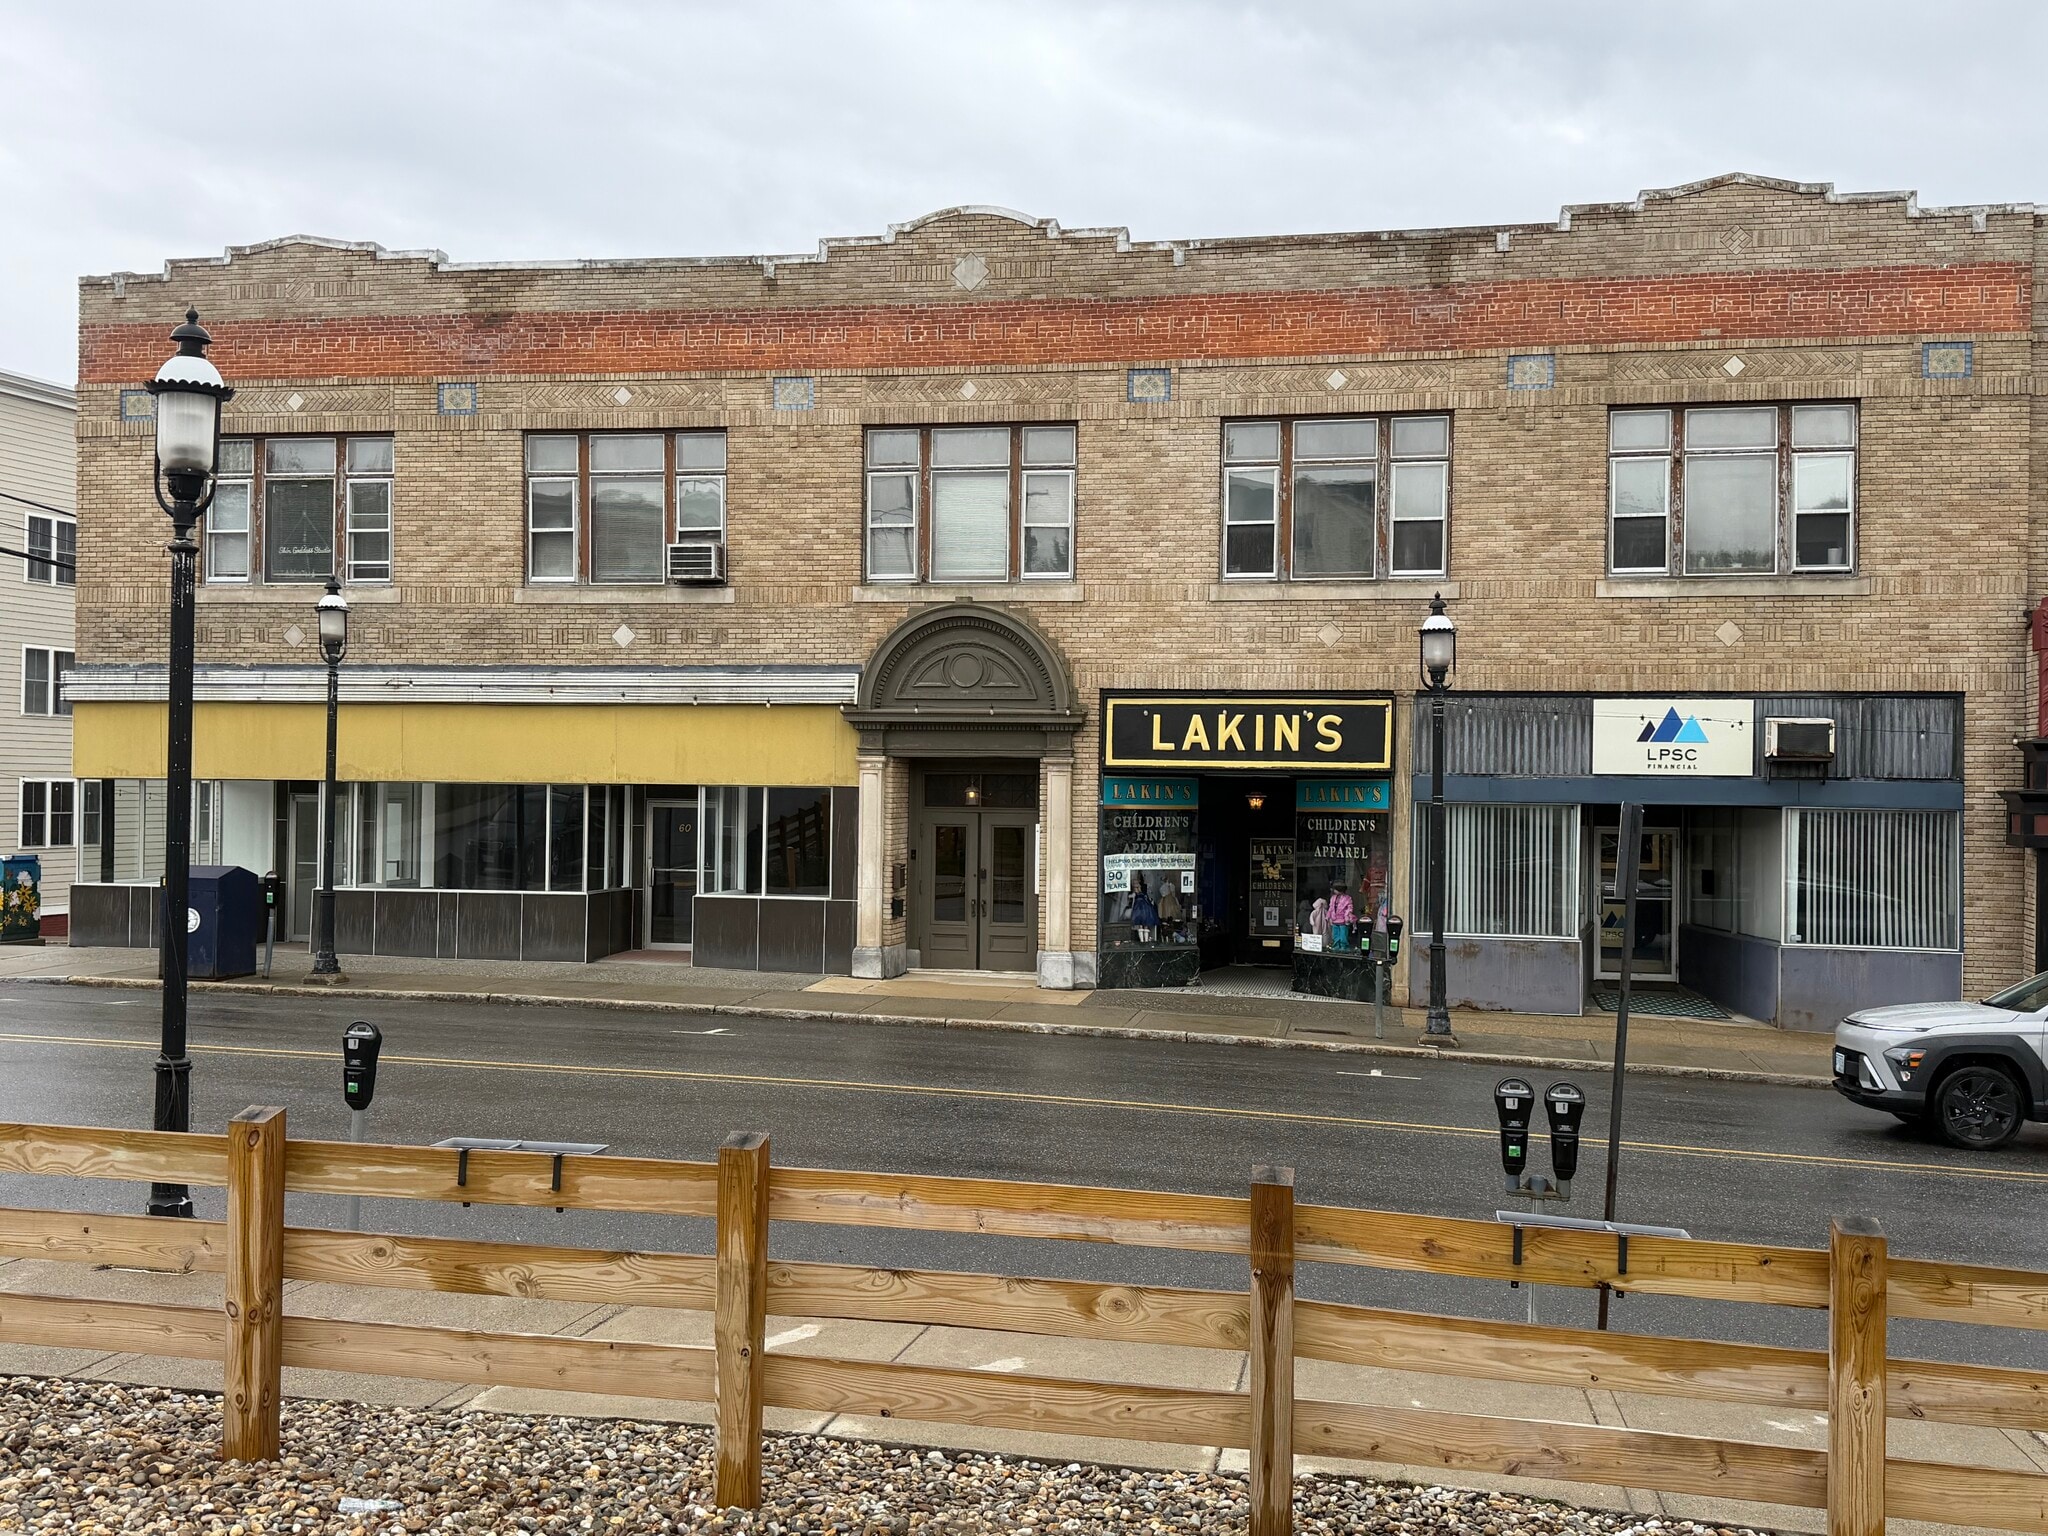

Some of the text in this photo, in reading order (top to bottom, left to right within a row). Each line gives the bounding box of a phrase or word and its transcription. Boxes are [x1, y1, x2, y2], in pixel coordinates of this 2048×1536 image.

[313, 546, 332, 554] Studio
[1152, 712, 1343, 752] LAKIN'S
[1647, 748, 1697, 761] LPSC
[1113, 784, 1192, 800] LAKIN'S
[1304, 786, 1382, 802] LAKIN'S
[678, 823, 692, 833] 60
[1113, 816, 1189, 828] CHILDREN'S
[1307, 818, 1376, 832] CHILDREN'S
[1136, 829, 1166, 841] FINE
[1326, 832, 1356, 845] FINE
[1123, 843, 1179, 854] APPAREL
[1253, 845, 1293, 855] LAKIN'S
[1314, 845, 1369, 859] APPAREL
[1108, 871, 1123, 881] 90
[1252, 882, 1293, 890] CHILDREN'S
[1264, 890, 1281, 898] FINE
